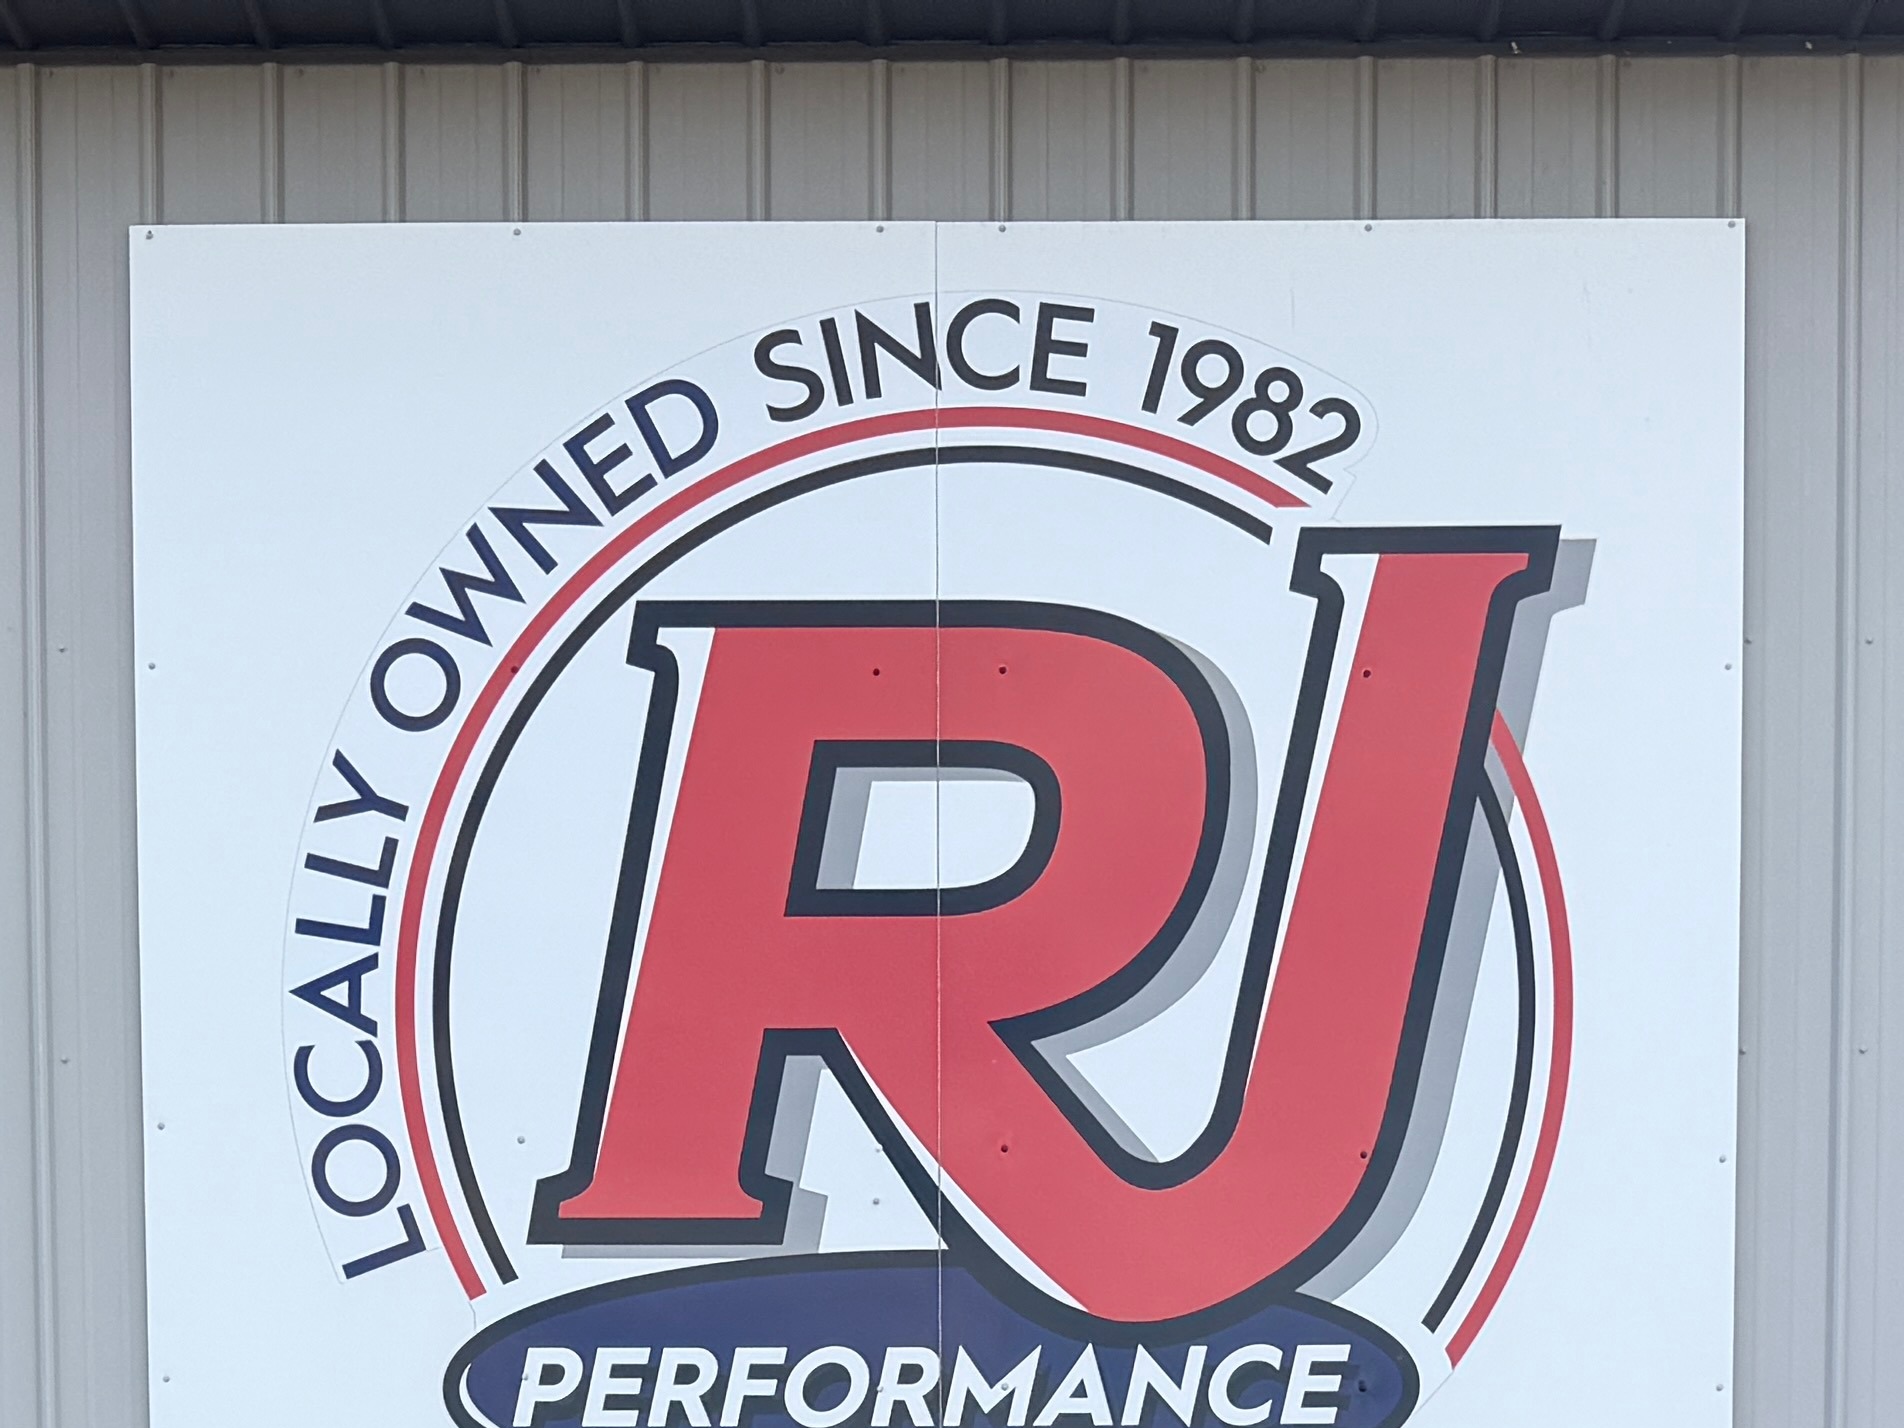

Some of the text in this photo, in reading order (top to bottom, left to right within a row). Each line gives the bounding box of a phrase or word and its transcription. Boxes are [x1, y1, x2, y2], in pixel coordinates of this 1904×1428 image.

[292, 298, 1362, 1279] LOCALLY OWNED SINCE 1982
[527, 525, 1563, 1342] RJ
